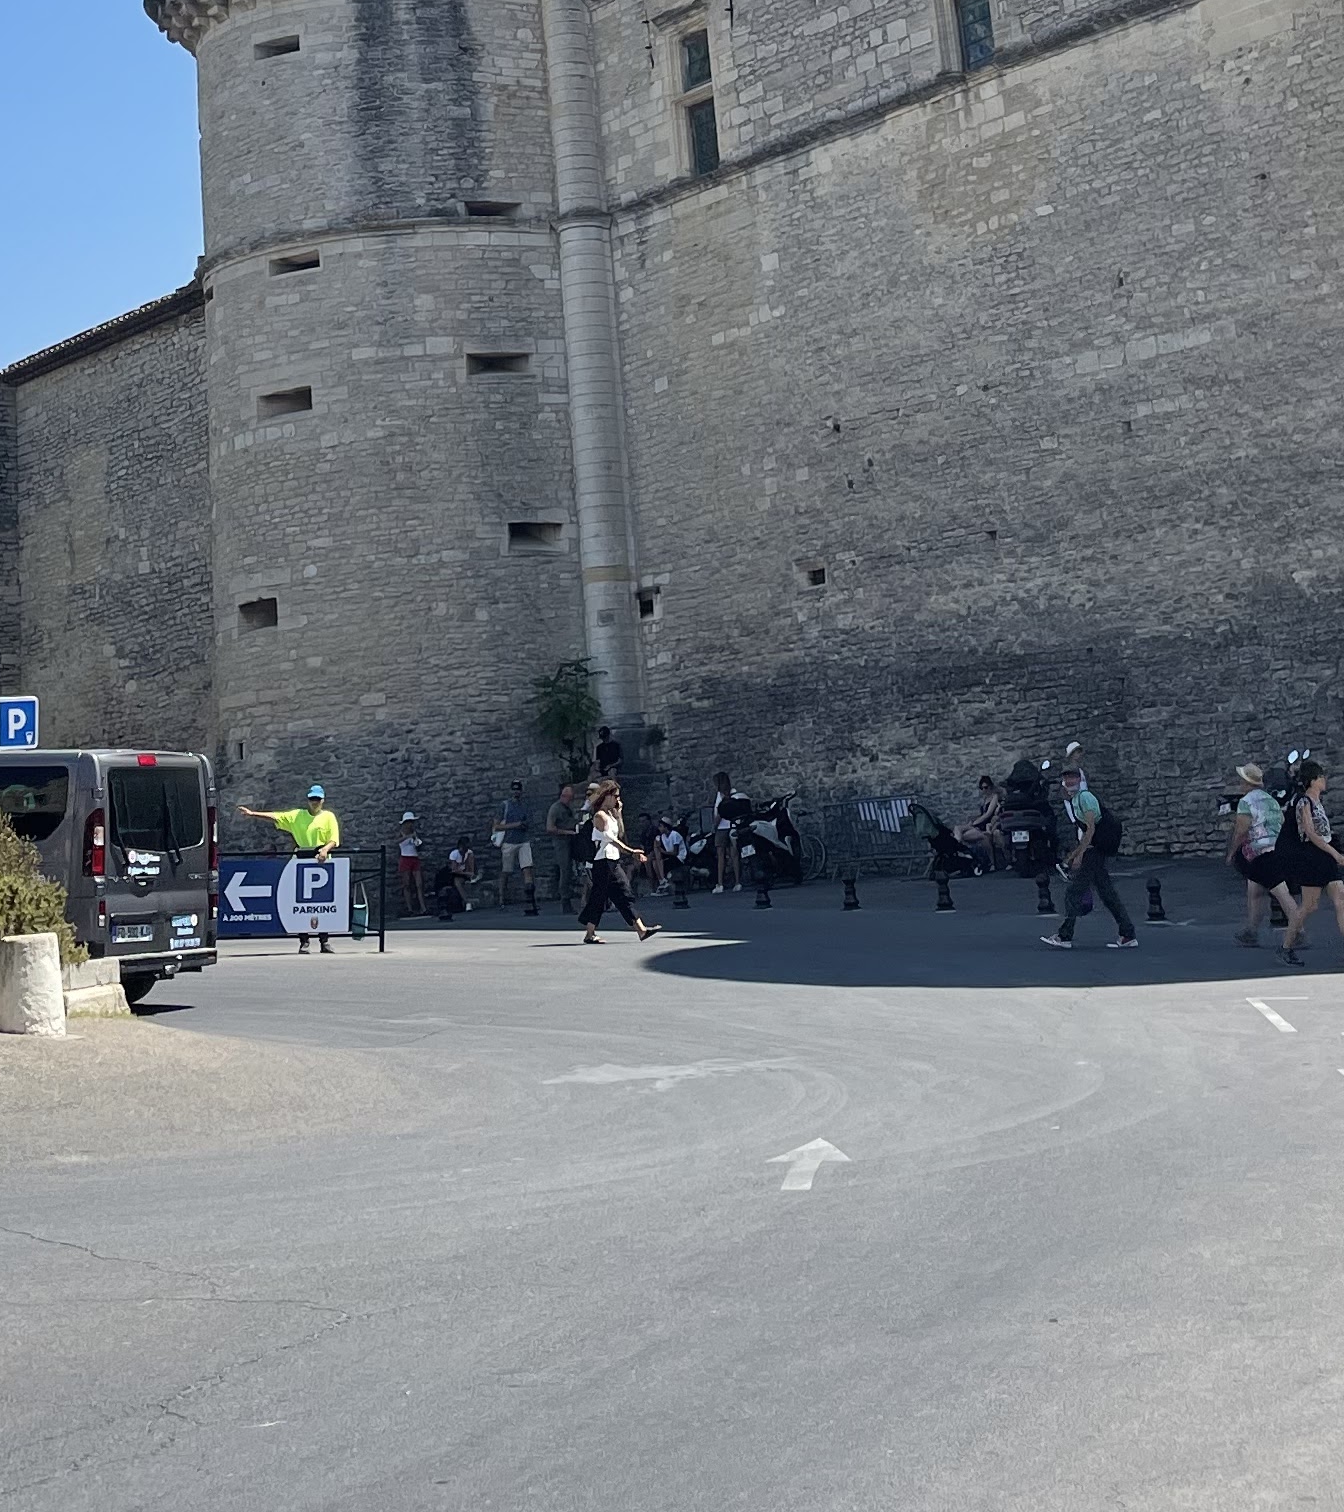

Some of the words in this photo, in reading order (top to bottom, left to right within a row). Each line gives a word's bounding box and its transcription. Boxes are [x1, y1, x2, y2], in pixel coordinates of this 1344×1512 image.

[8, 708, 27, 739] P
[303, 867, 329, 899] P
[292, 905, 337, 915] PARKING
